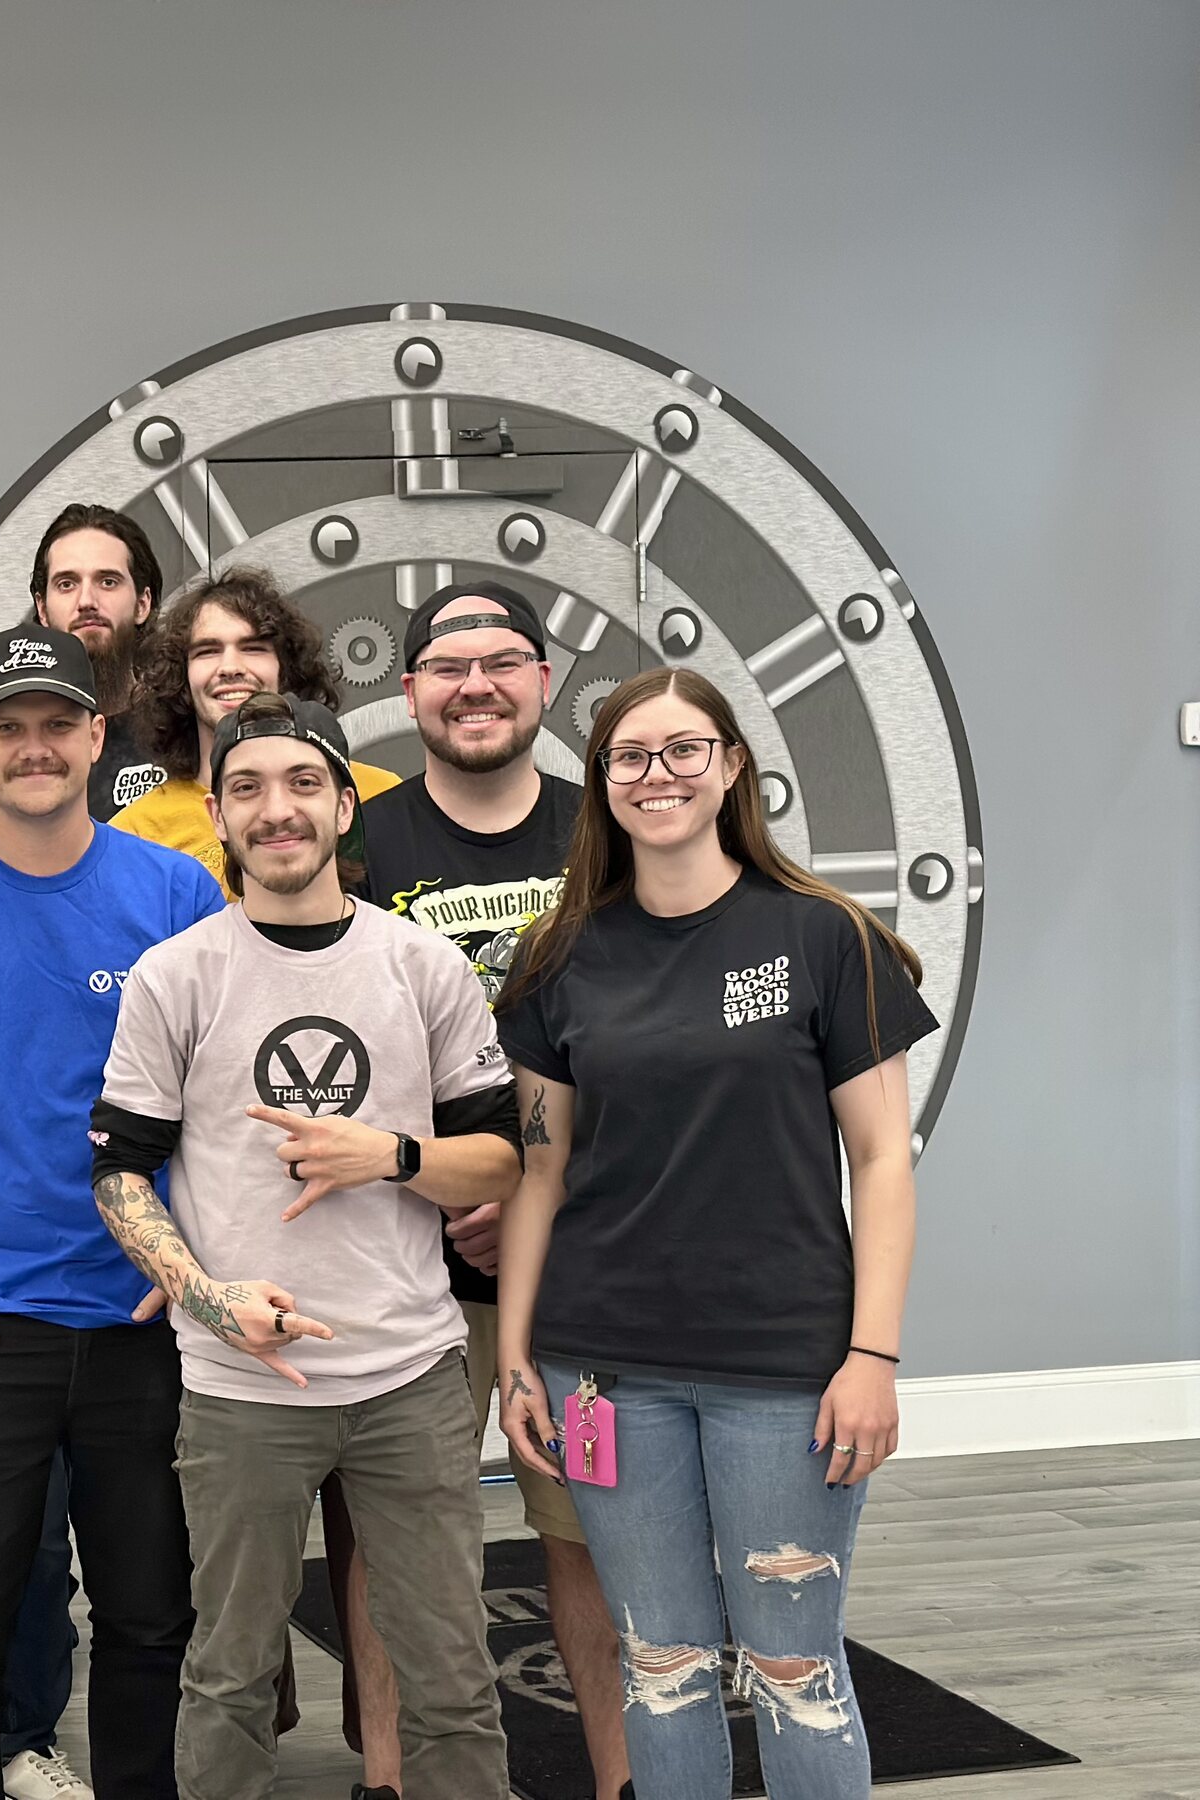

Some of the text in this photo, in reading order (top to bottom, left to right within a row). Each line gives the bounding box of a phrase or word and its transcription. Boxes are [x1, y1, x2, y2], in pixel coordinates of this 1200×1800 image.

[9, 638, 53, 654] Have
[3, 650, 58, 669] A Day
[119, 769, 164, 788] GOOD
[424, 895, 482, 929] YOUR
[724, 956, 790, 982] GOOD
[724, 970, 790, 998] MOOD
[723, 987, 790, 1013] GOOD
[723, 1004, 790, 1029] WEED
[272, 1087, 354, 1101] THE VAULT
